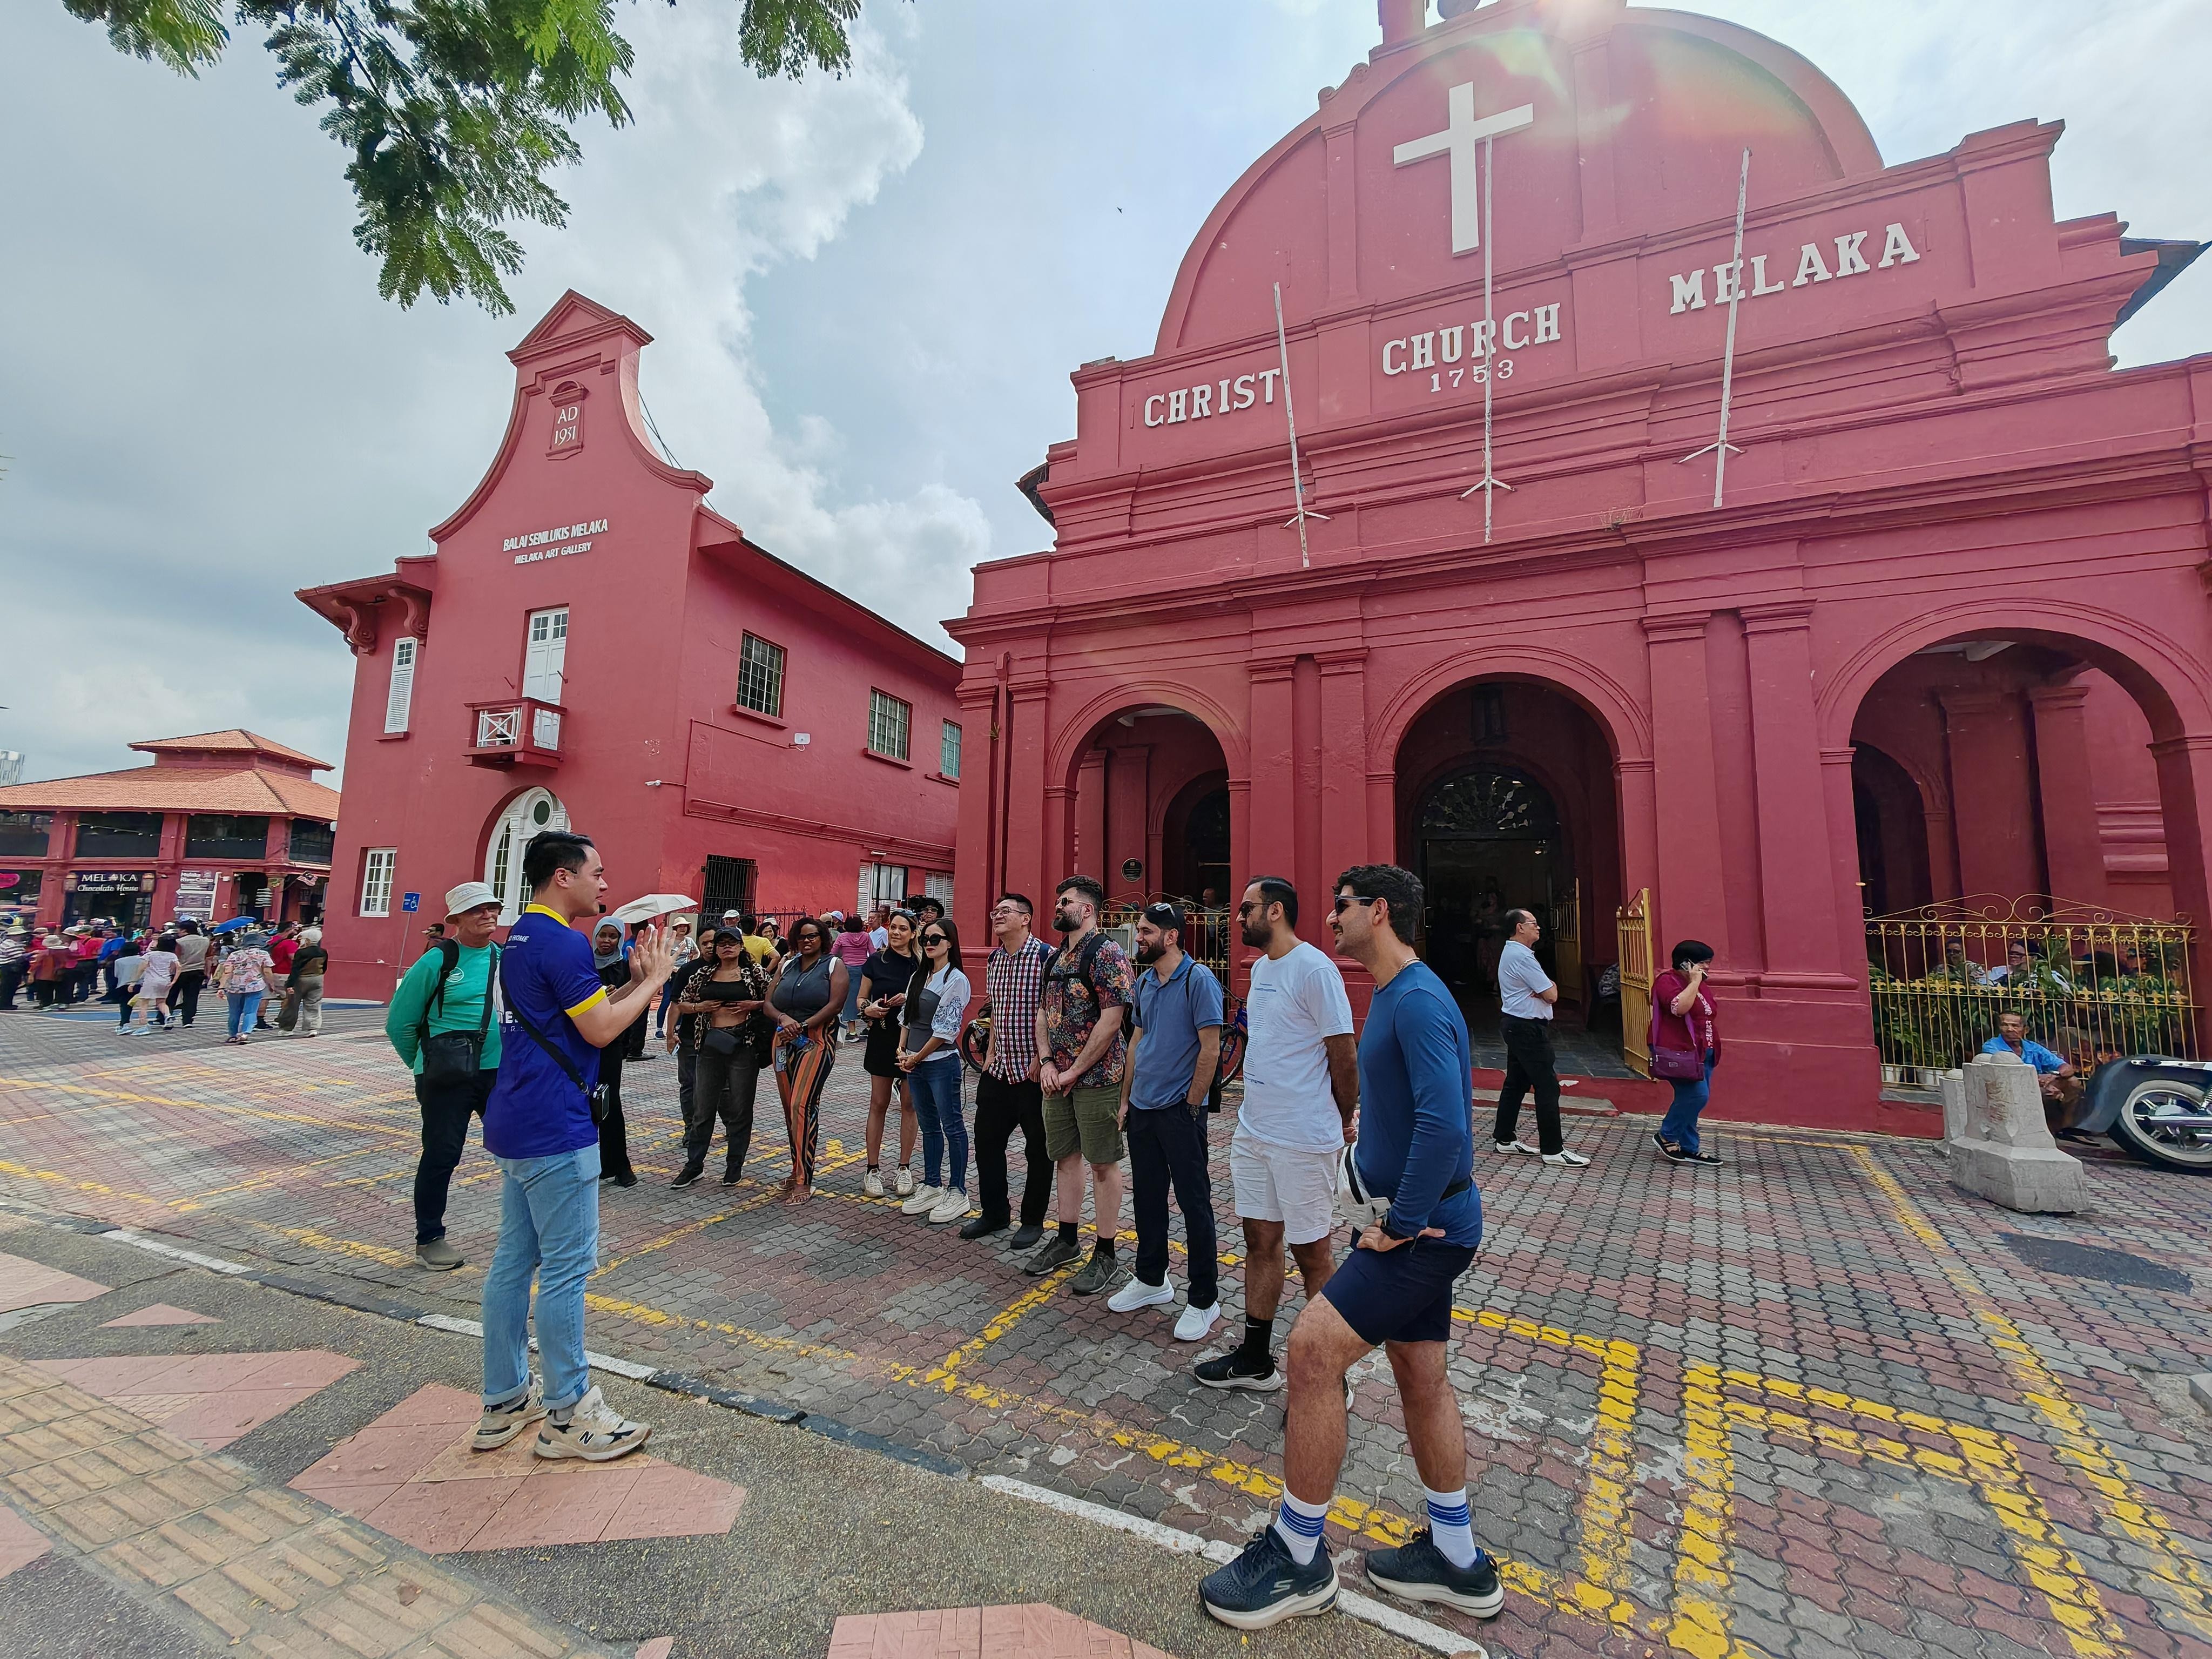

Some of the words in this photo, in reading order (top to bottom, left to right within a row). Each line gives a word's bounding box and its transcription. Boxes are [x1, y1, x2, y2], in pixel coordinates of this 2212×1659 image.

[1669, 222, 1920, 315] MELAKA
[1382, 302, 1561, 375] CHURCH
[1431, 360, 1514, 392] 1753
[1145, 368, 1280, 427] CHRIST
[557, 407, 578, 423] AD
[555, 426, 576, 446] 1931
[503, 535, 528, 551] BALAI
[571, 518, 608, 538] MELAKA
[514, 551, 543, 564] MELAKA
[545, 548, 559, 559] ART
[561, 542, 592, 555] GALLERY
[578, 1429, 595, 1446] N
